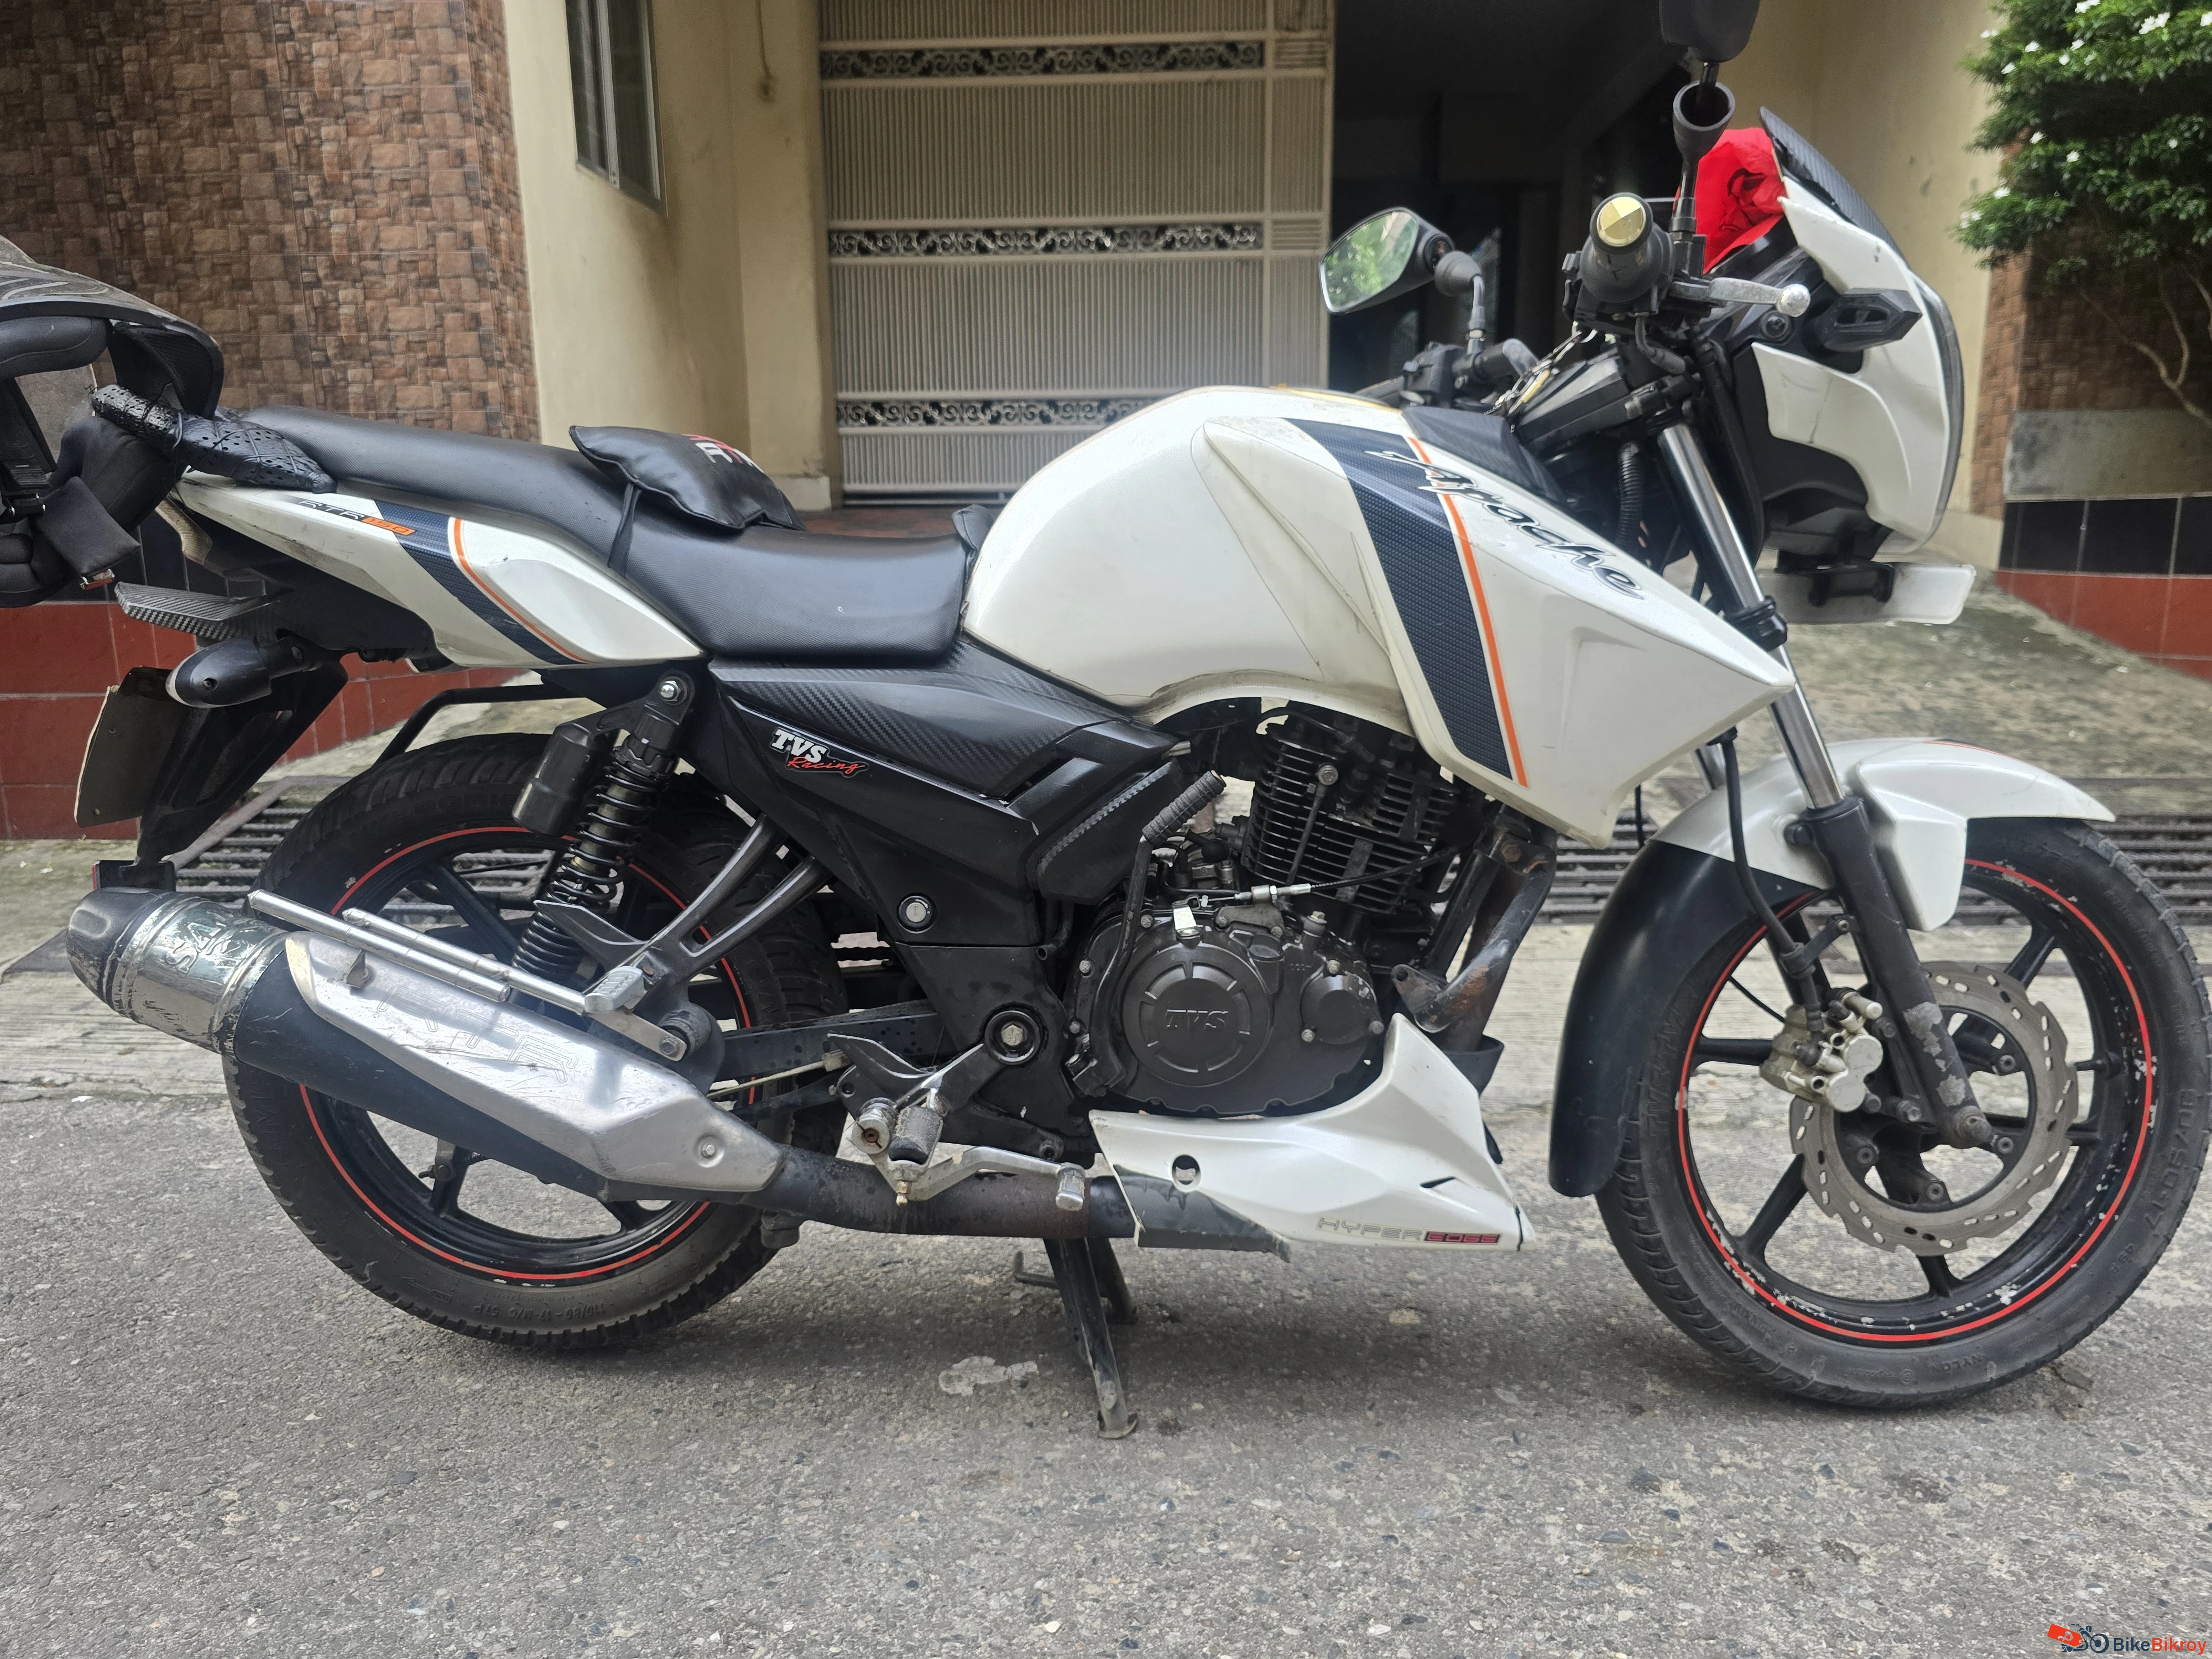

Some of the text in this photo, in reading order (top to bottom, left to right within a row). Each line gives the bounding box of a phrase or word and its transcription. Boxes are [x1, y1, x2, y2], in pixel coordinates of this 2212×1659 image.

[1364, 450, 1645, 601] Apache
[771, 729, 827, 763] TVS
[787, 757, 865, 774] Racing
[1164, 1009, 1229, 1032] TVS
